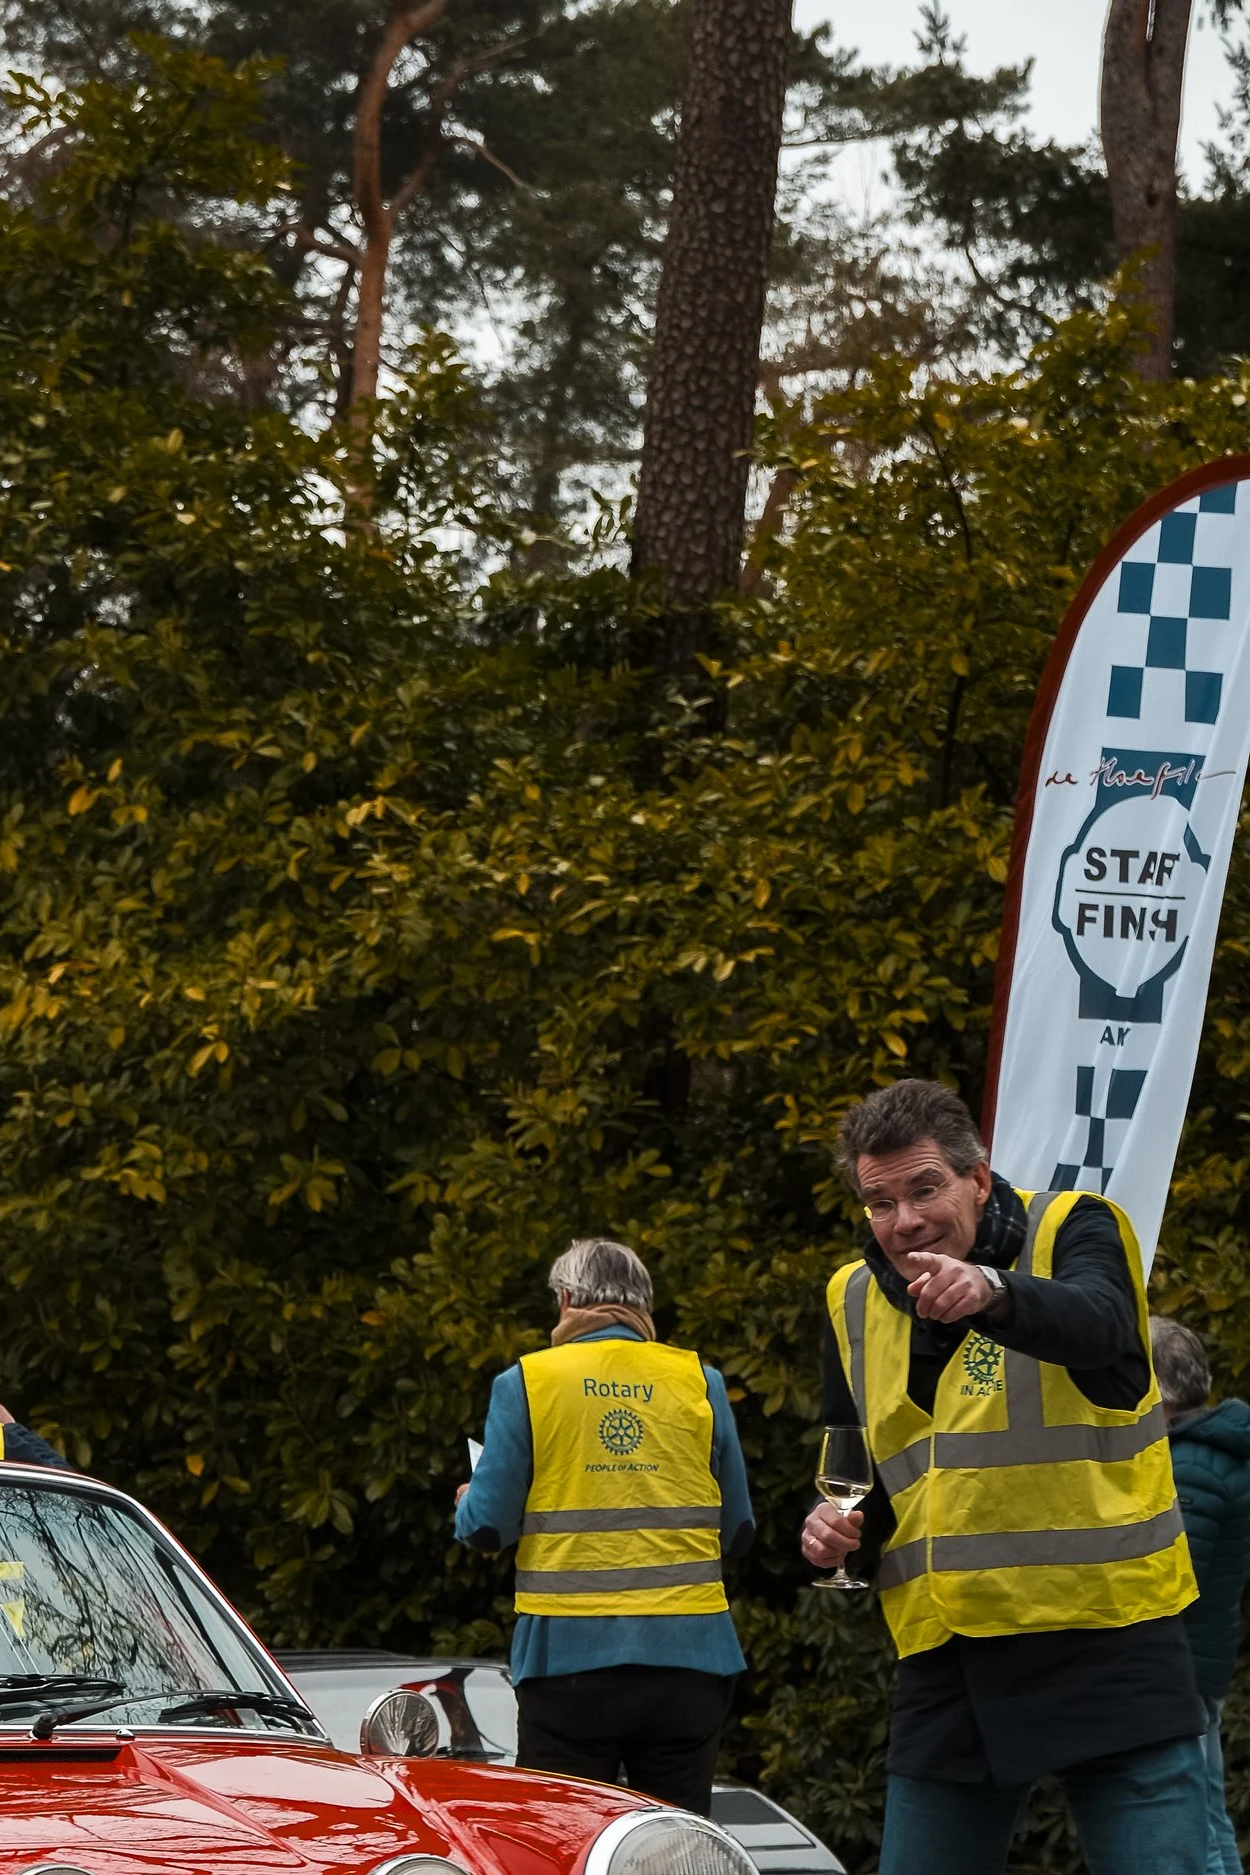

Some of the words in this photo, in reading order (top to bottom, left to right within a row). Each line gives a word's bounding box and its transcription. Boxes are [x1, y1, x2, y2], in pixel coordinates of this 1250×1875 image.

[1083, 846, 1181, 887] STAR
[583, 1378, 654, 1403] Rotary
[584, 1463, 617, 1472] PEOPLE
[628, 1463, 660, 1472] ACTION
